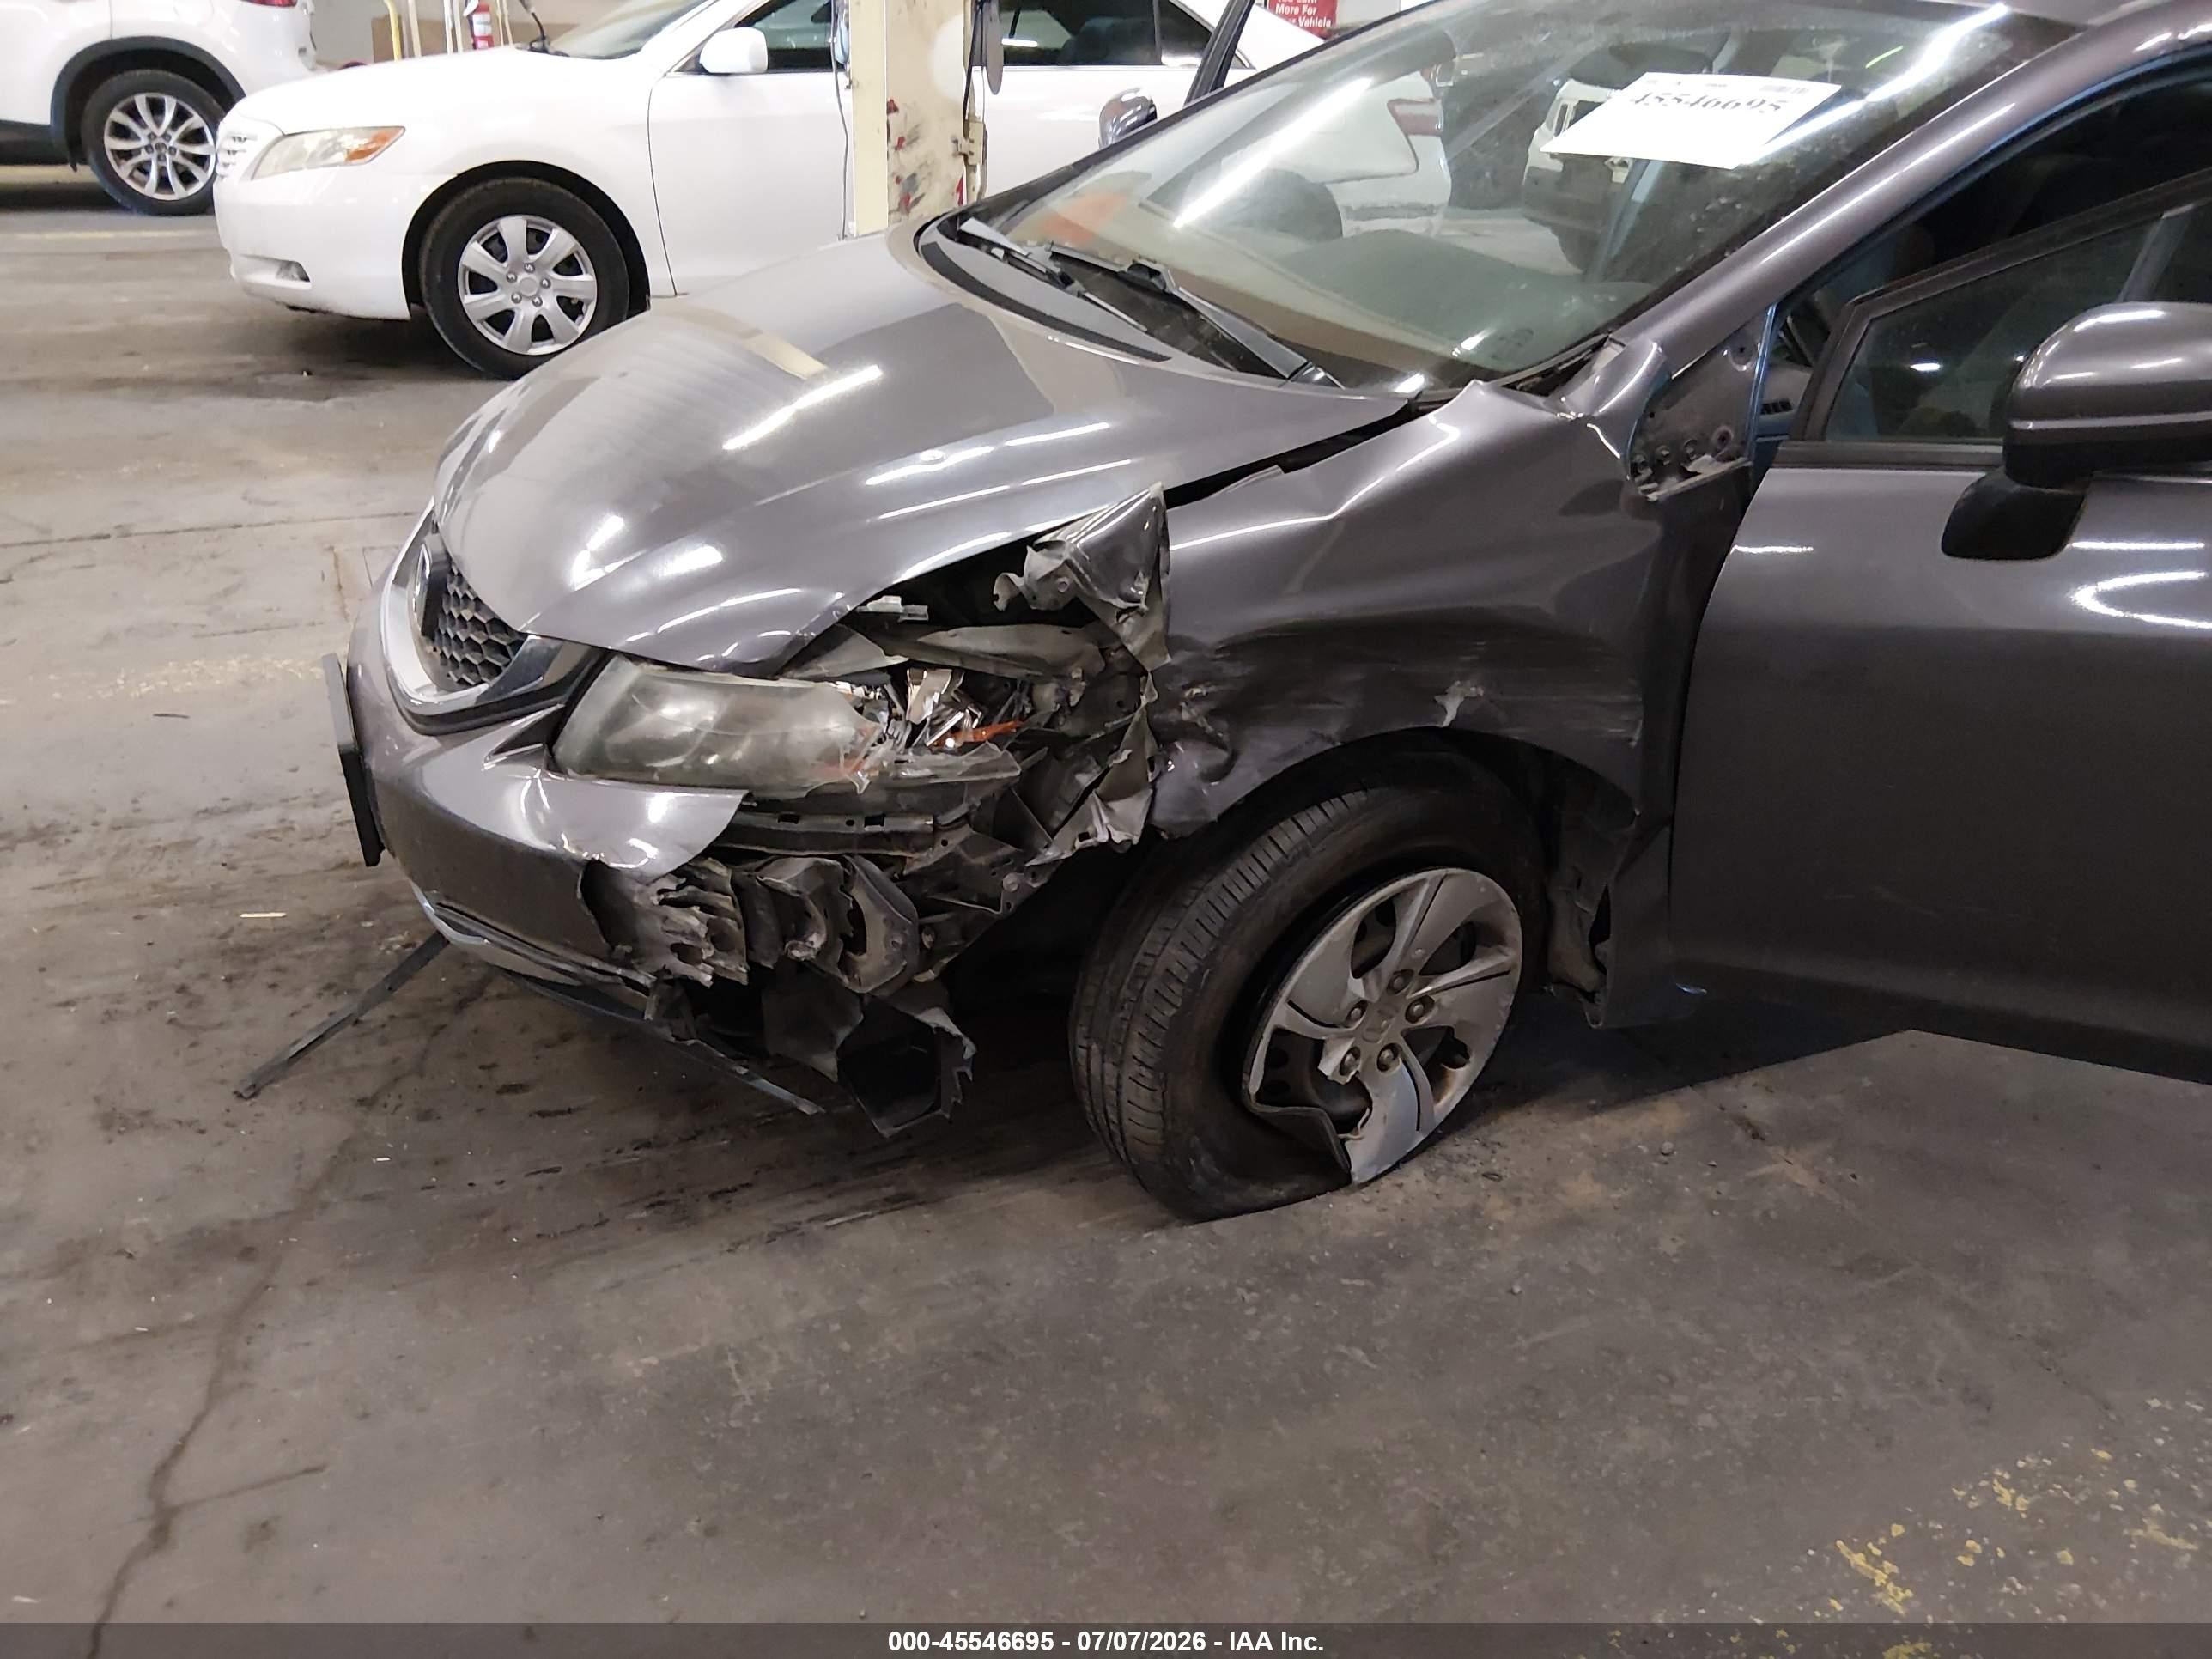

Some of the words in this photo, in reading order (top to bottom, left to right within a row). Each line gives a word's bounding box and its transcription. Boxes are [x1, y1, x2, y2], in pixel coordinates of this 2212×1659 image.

[1275, 3, 1299, 15] More
[1302, 4, 1317, 15] For
[1298, 15, 1332, 28] Vehicle
